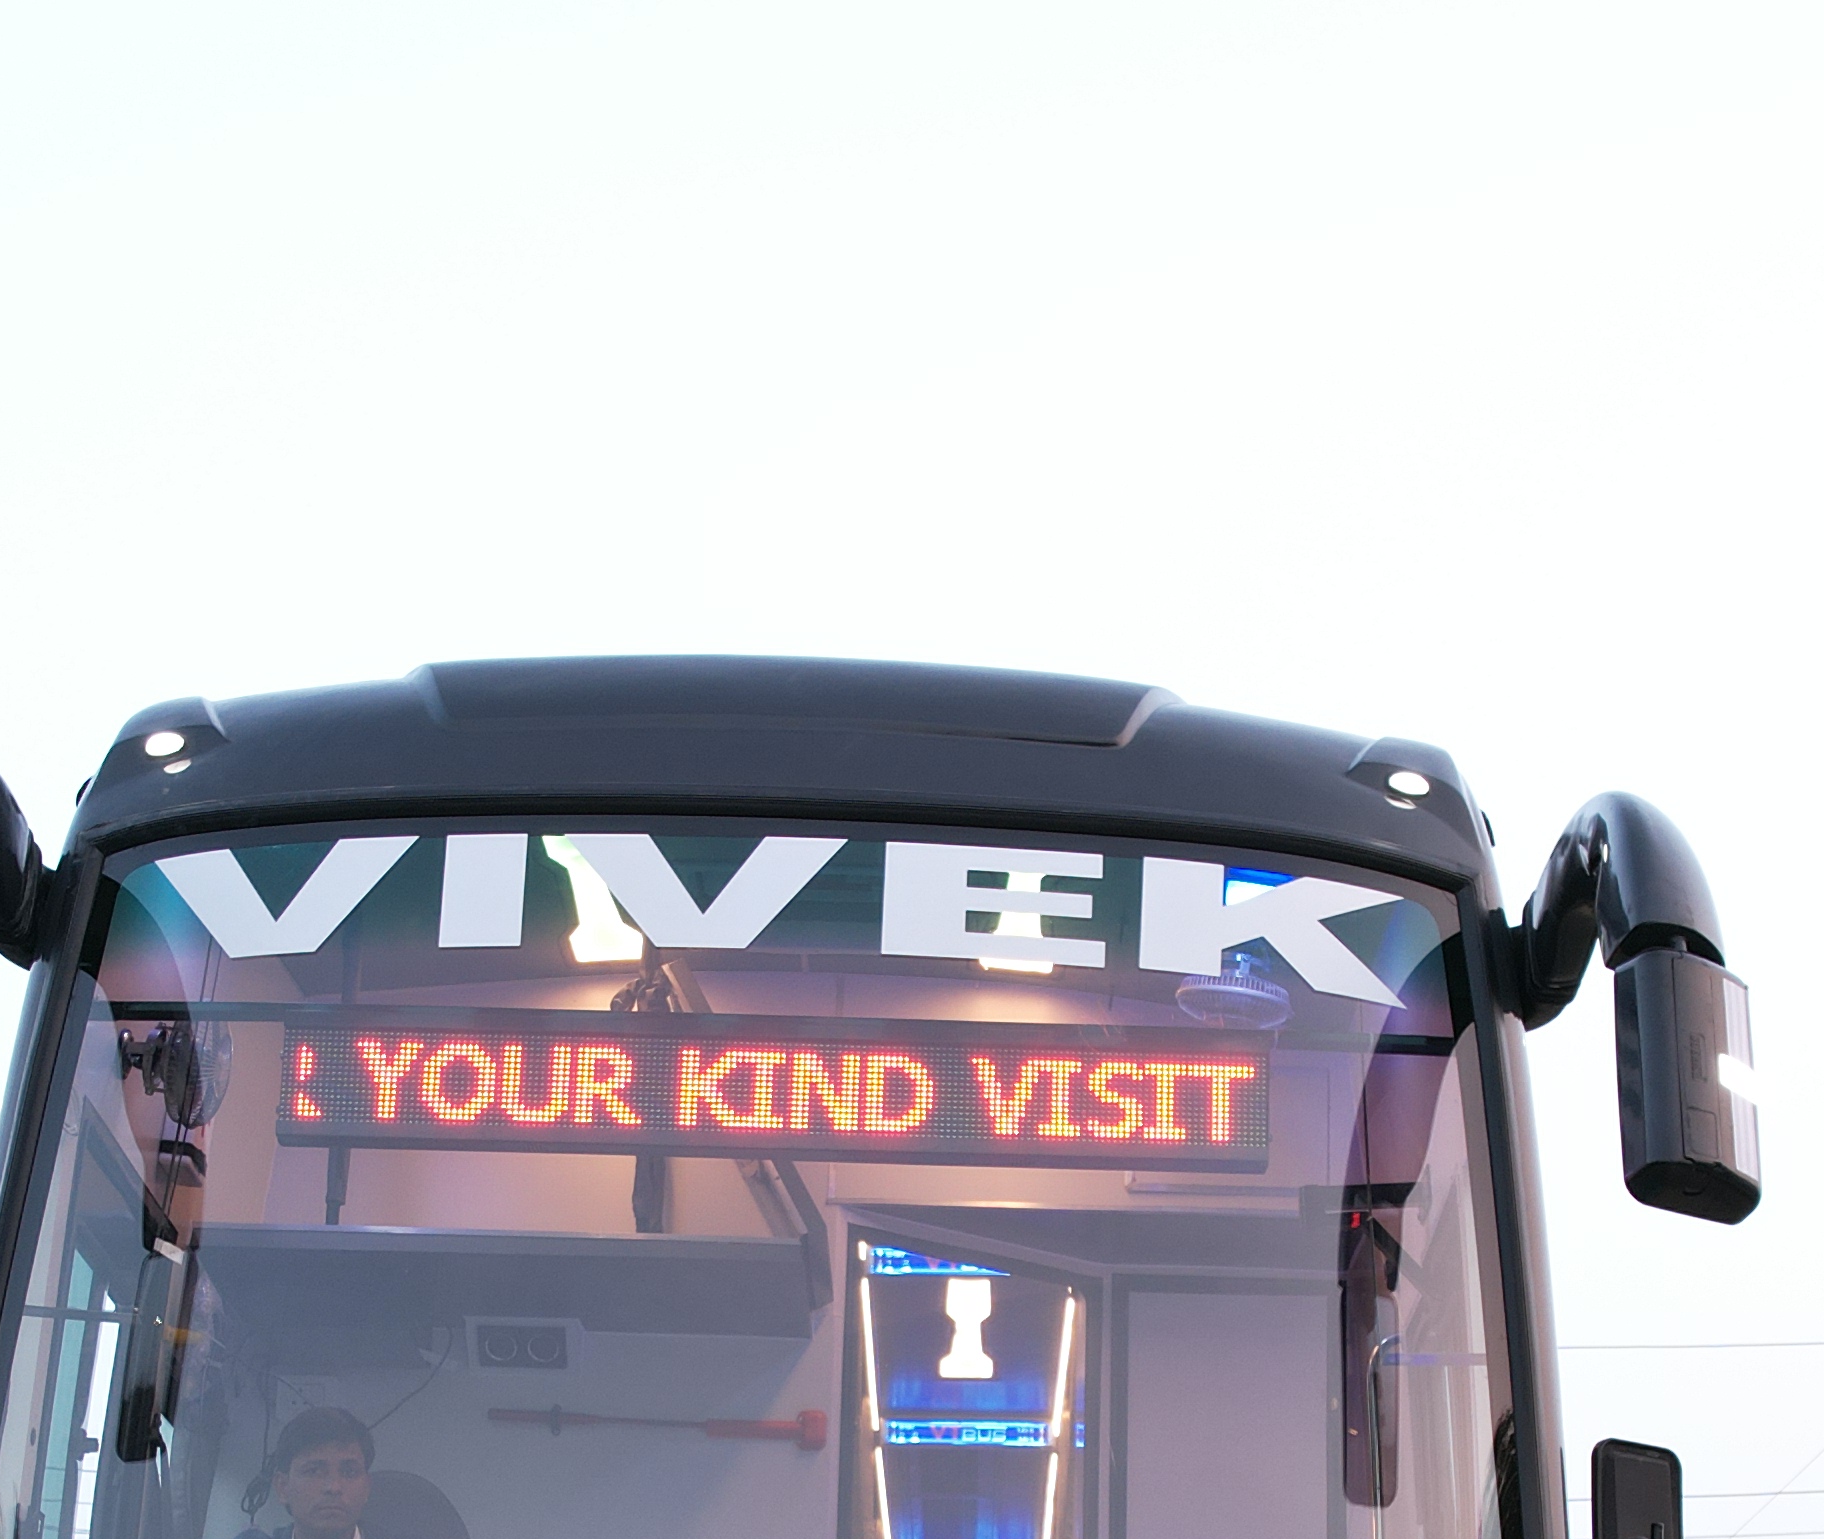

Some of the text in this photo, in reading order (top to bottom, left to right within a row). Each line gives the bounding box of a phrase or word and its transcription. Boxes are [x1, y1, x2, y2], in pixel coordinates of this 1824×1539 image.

[156, 833, 1407, 1008] VIVEK
[356, 1037, 643, 1125] YOUR
[678, 1048, 935, 1133] KIND
[971, 1056, 1257, 1142] VISIT
